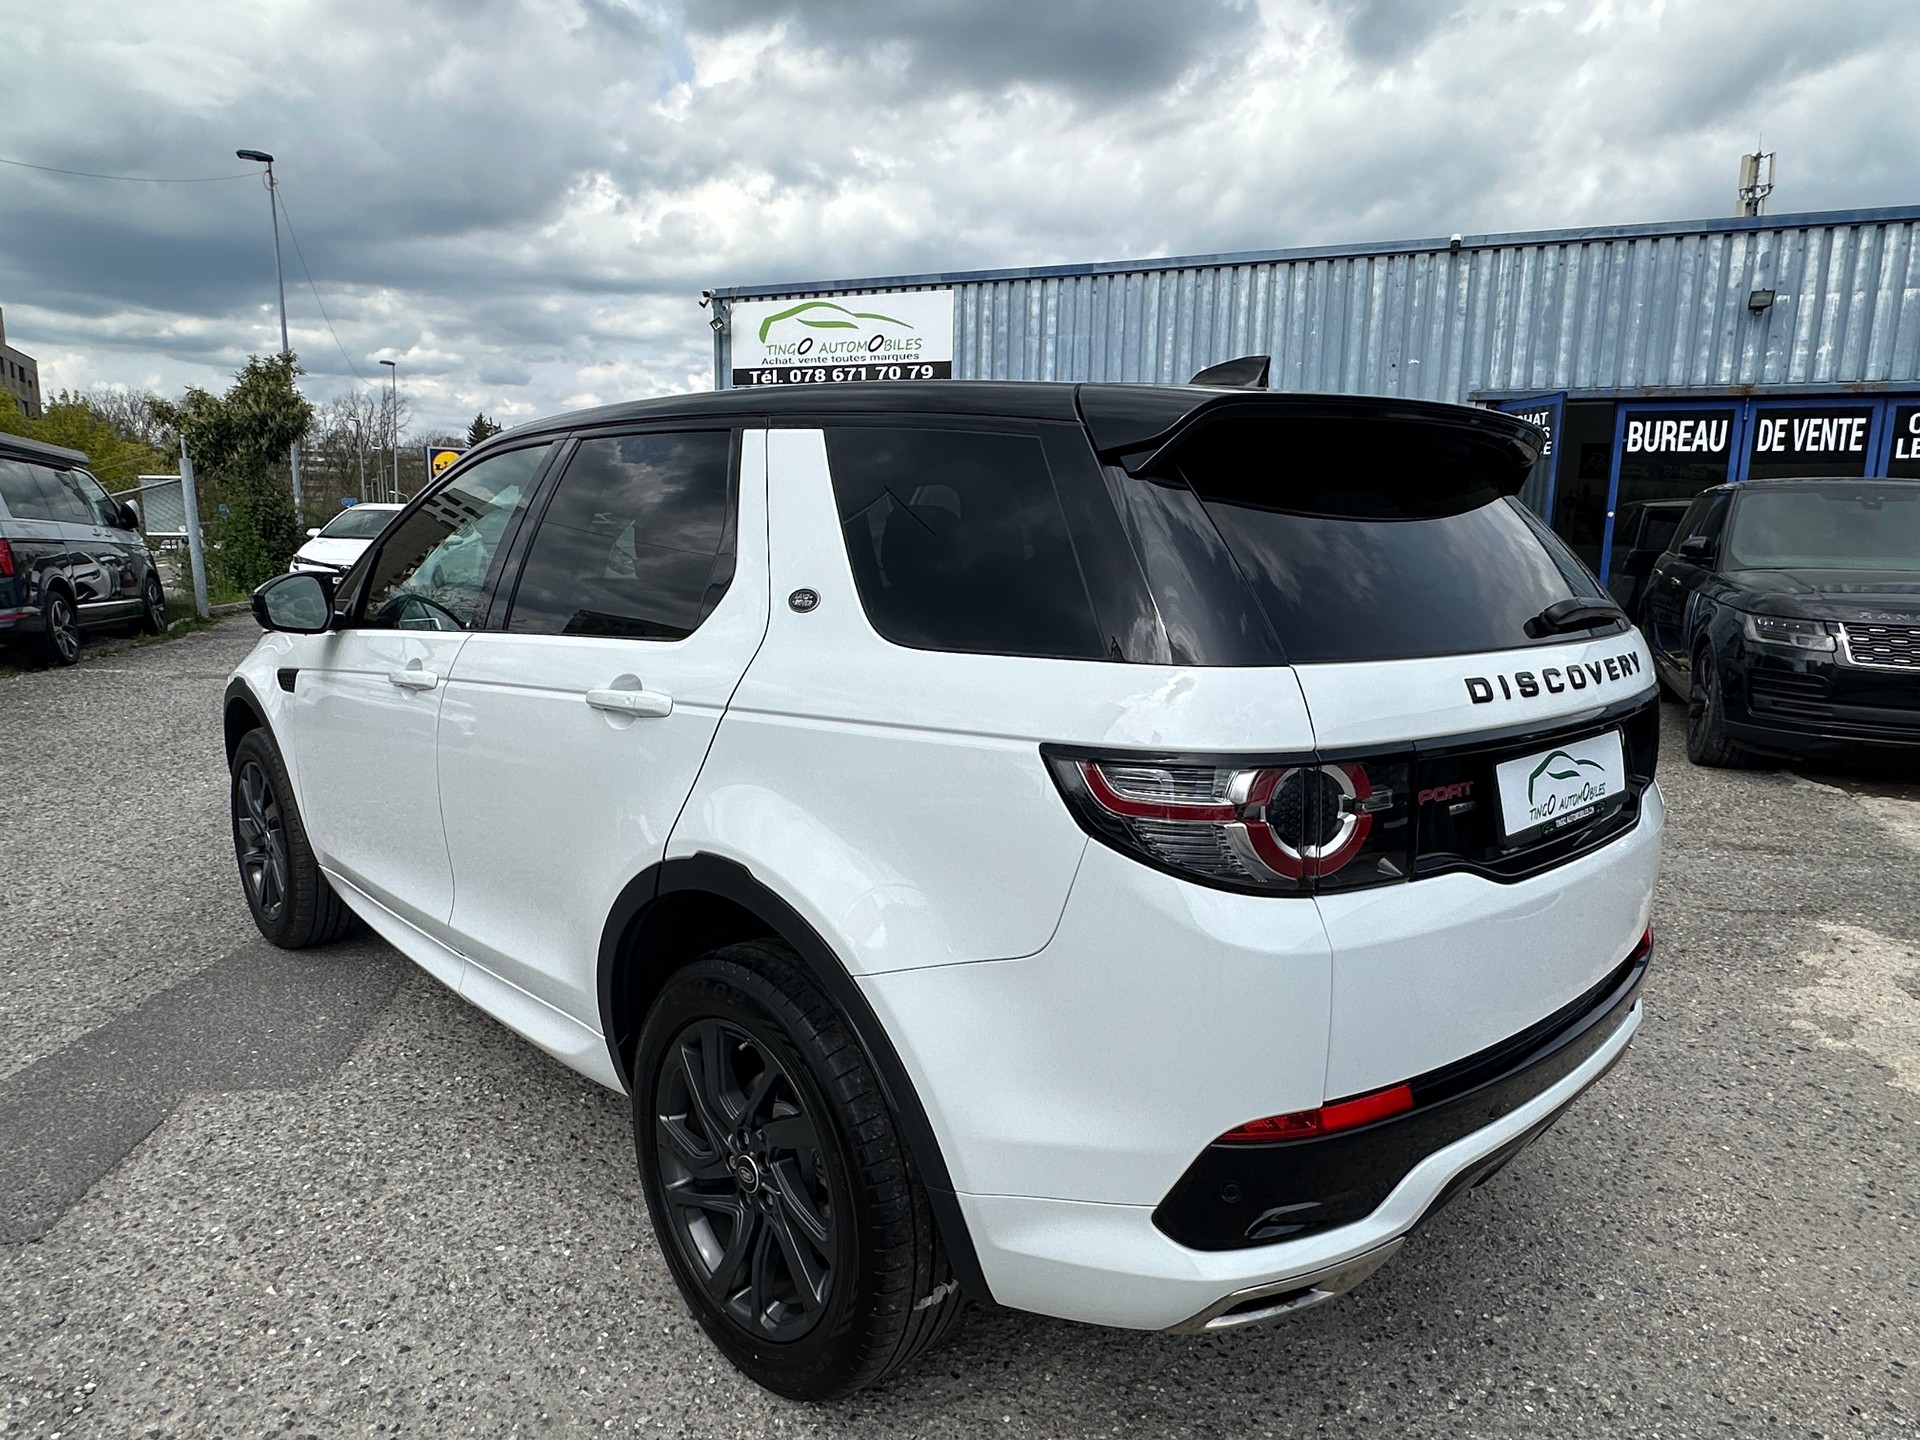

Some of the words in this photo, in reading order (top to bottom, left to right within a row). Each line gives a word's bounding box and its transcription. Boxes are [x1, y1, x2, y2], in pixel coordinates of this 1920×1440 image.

[766, 338, 813, 356] TINGO
[819, 335, 922, 354] AUTOMOBILES
[798, 356, 828, 364] vente
[832, 355, 866, 363] toutes
[869, 353, 919, 361] marques
[749, 370, 783, 384] Tél.
[789, 369, 826, 383] 078
[832, 367, 867, 382] 671
[875, 366, 901, 380] 70
[907, 364, 933, 379] 79
[1626, 420, 1728, 453] BUREAU
[1757, 419, 1788, 451] DE
[1793, 418, 1867, 451] VENTE
[1464, 651, 1641, 704] DISCOVERY
[1418, 781, 1474, 805] PORT
[1529, 793, 1556, 821] TINGO
[1558, 782, 1606, 811] AUTOMOBILES
